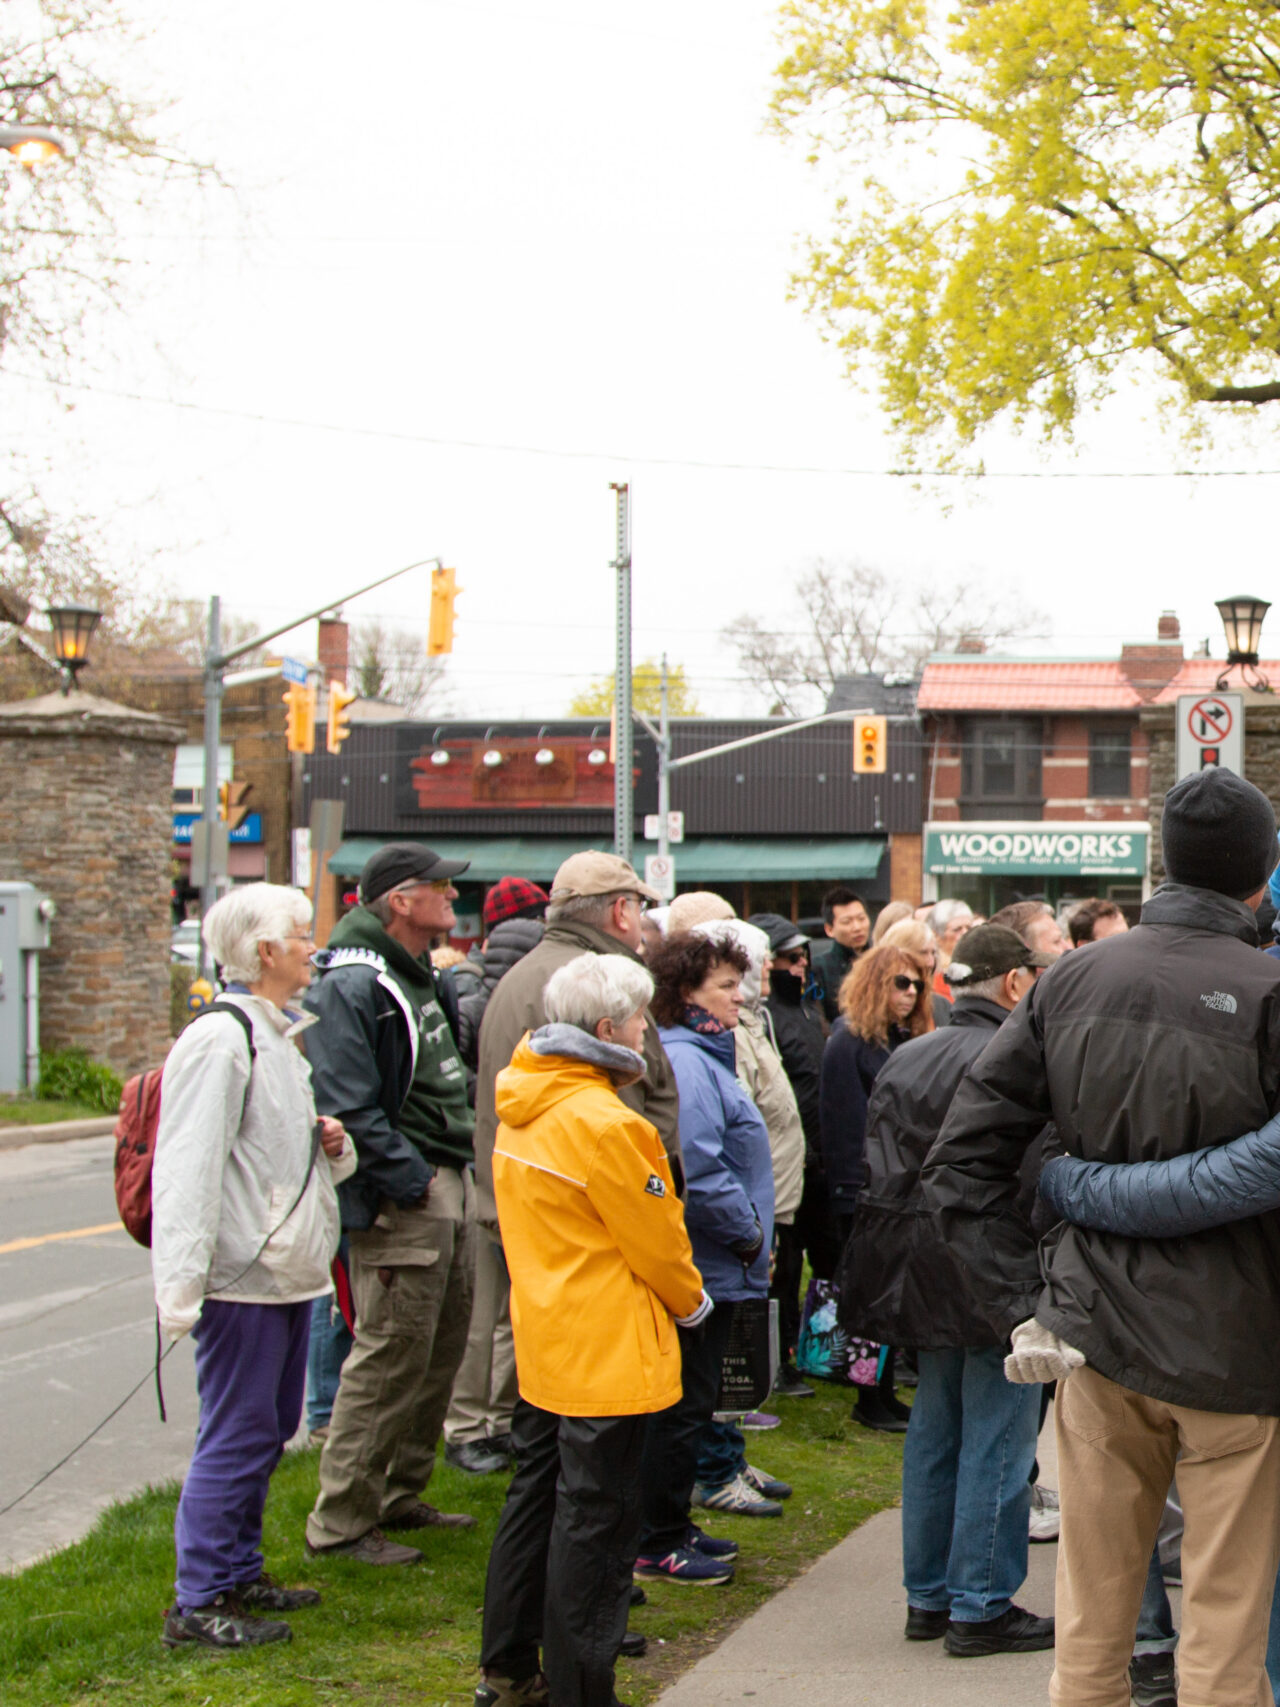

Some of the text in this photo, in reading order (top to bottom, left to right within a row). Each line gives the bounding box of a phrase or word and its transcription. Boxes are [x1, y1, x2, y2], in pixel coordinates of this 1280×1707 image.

[939, 834, 1132, 857] WOODWORKS
[1213, 991, 1227, 999] THE
[1200, 994, 1226, 1006] NORTH
[1205, 1001, 1225, 1011] FACE
[722, 1357, 747, 1366] THIS
[722, 1367, 732, 1375] IS
